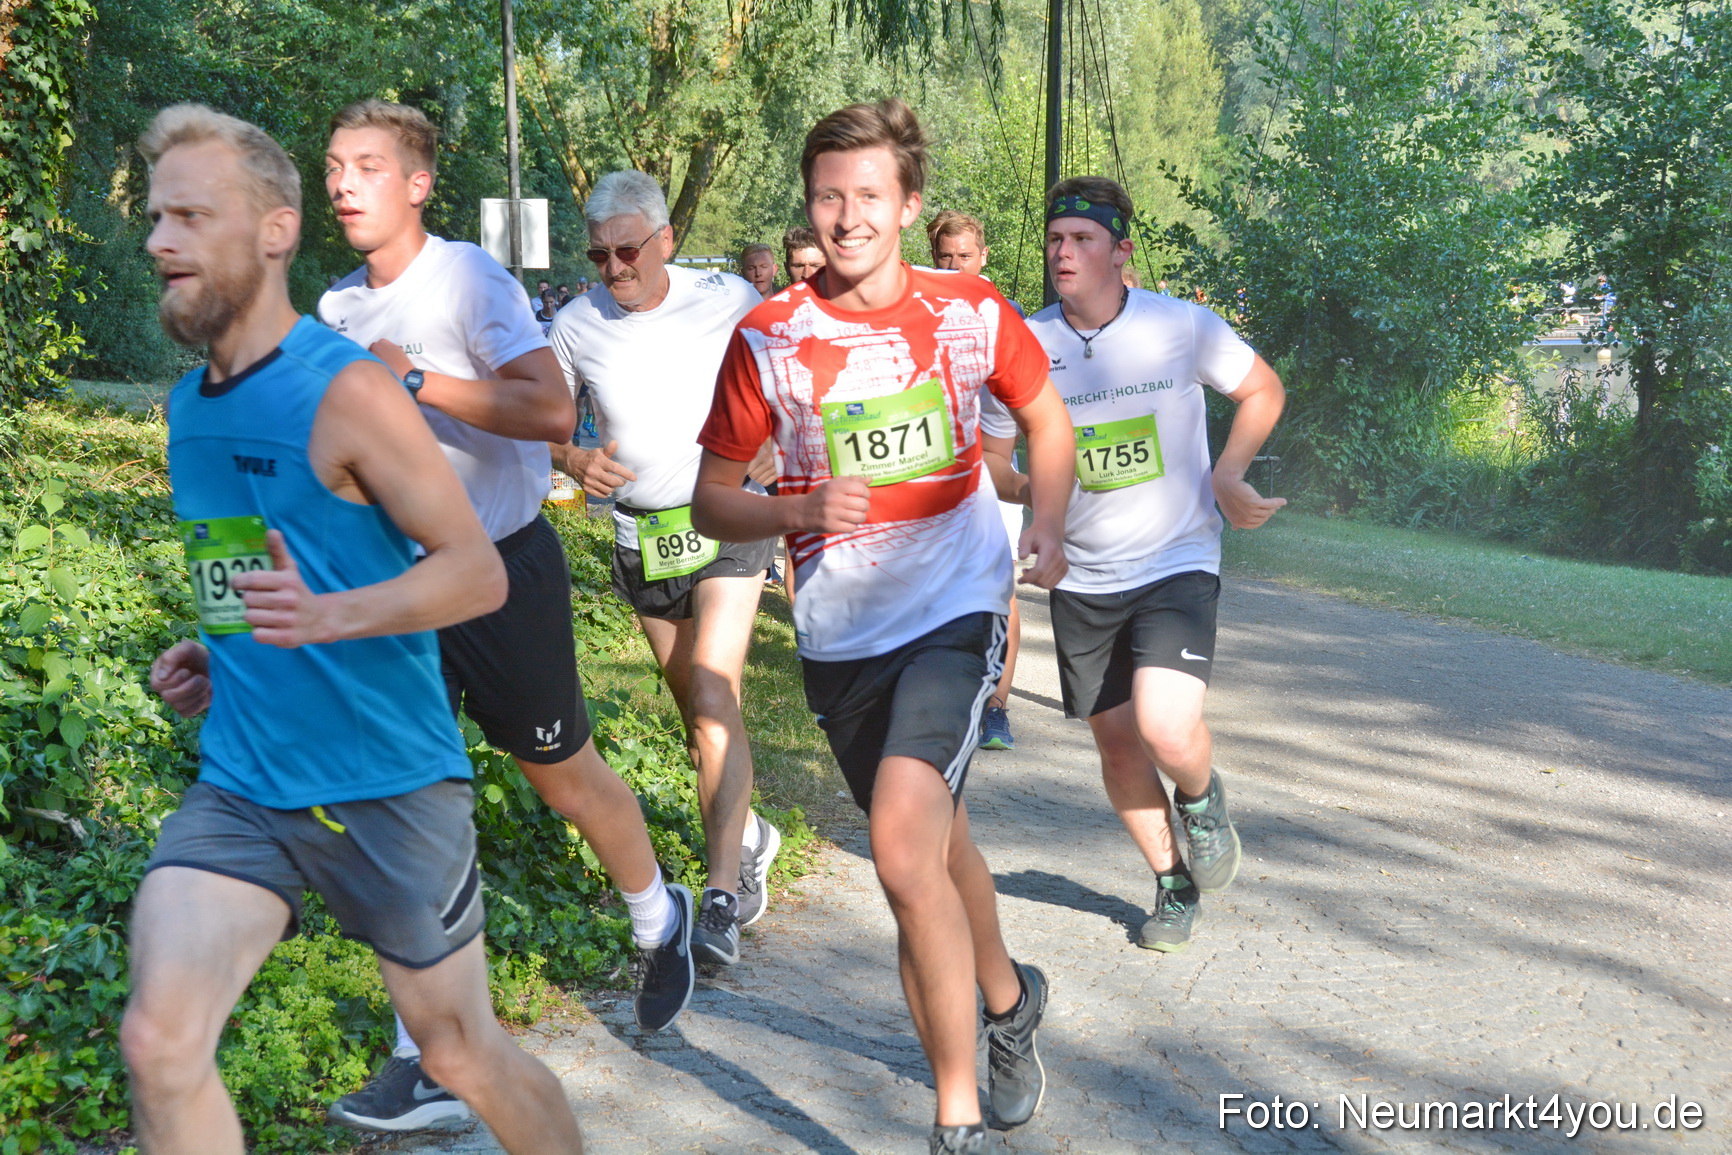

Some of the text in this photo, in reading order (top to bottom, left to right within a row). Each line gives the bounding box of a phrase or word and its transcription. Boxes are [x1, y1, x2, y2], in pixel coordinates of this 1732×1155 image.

[400, 342, 423, 355] AU
[1115, 379, 1173, 397] HOLZBAU
[844, 416, 932, 462] 1871
[860, 450, 929, 472] Zimmer Marcel
[1082, 439, 1150, 472] 1755
[1098, 467, 1137, 479] Lurk Jonas
[657, 530, 702, 559] 698
